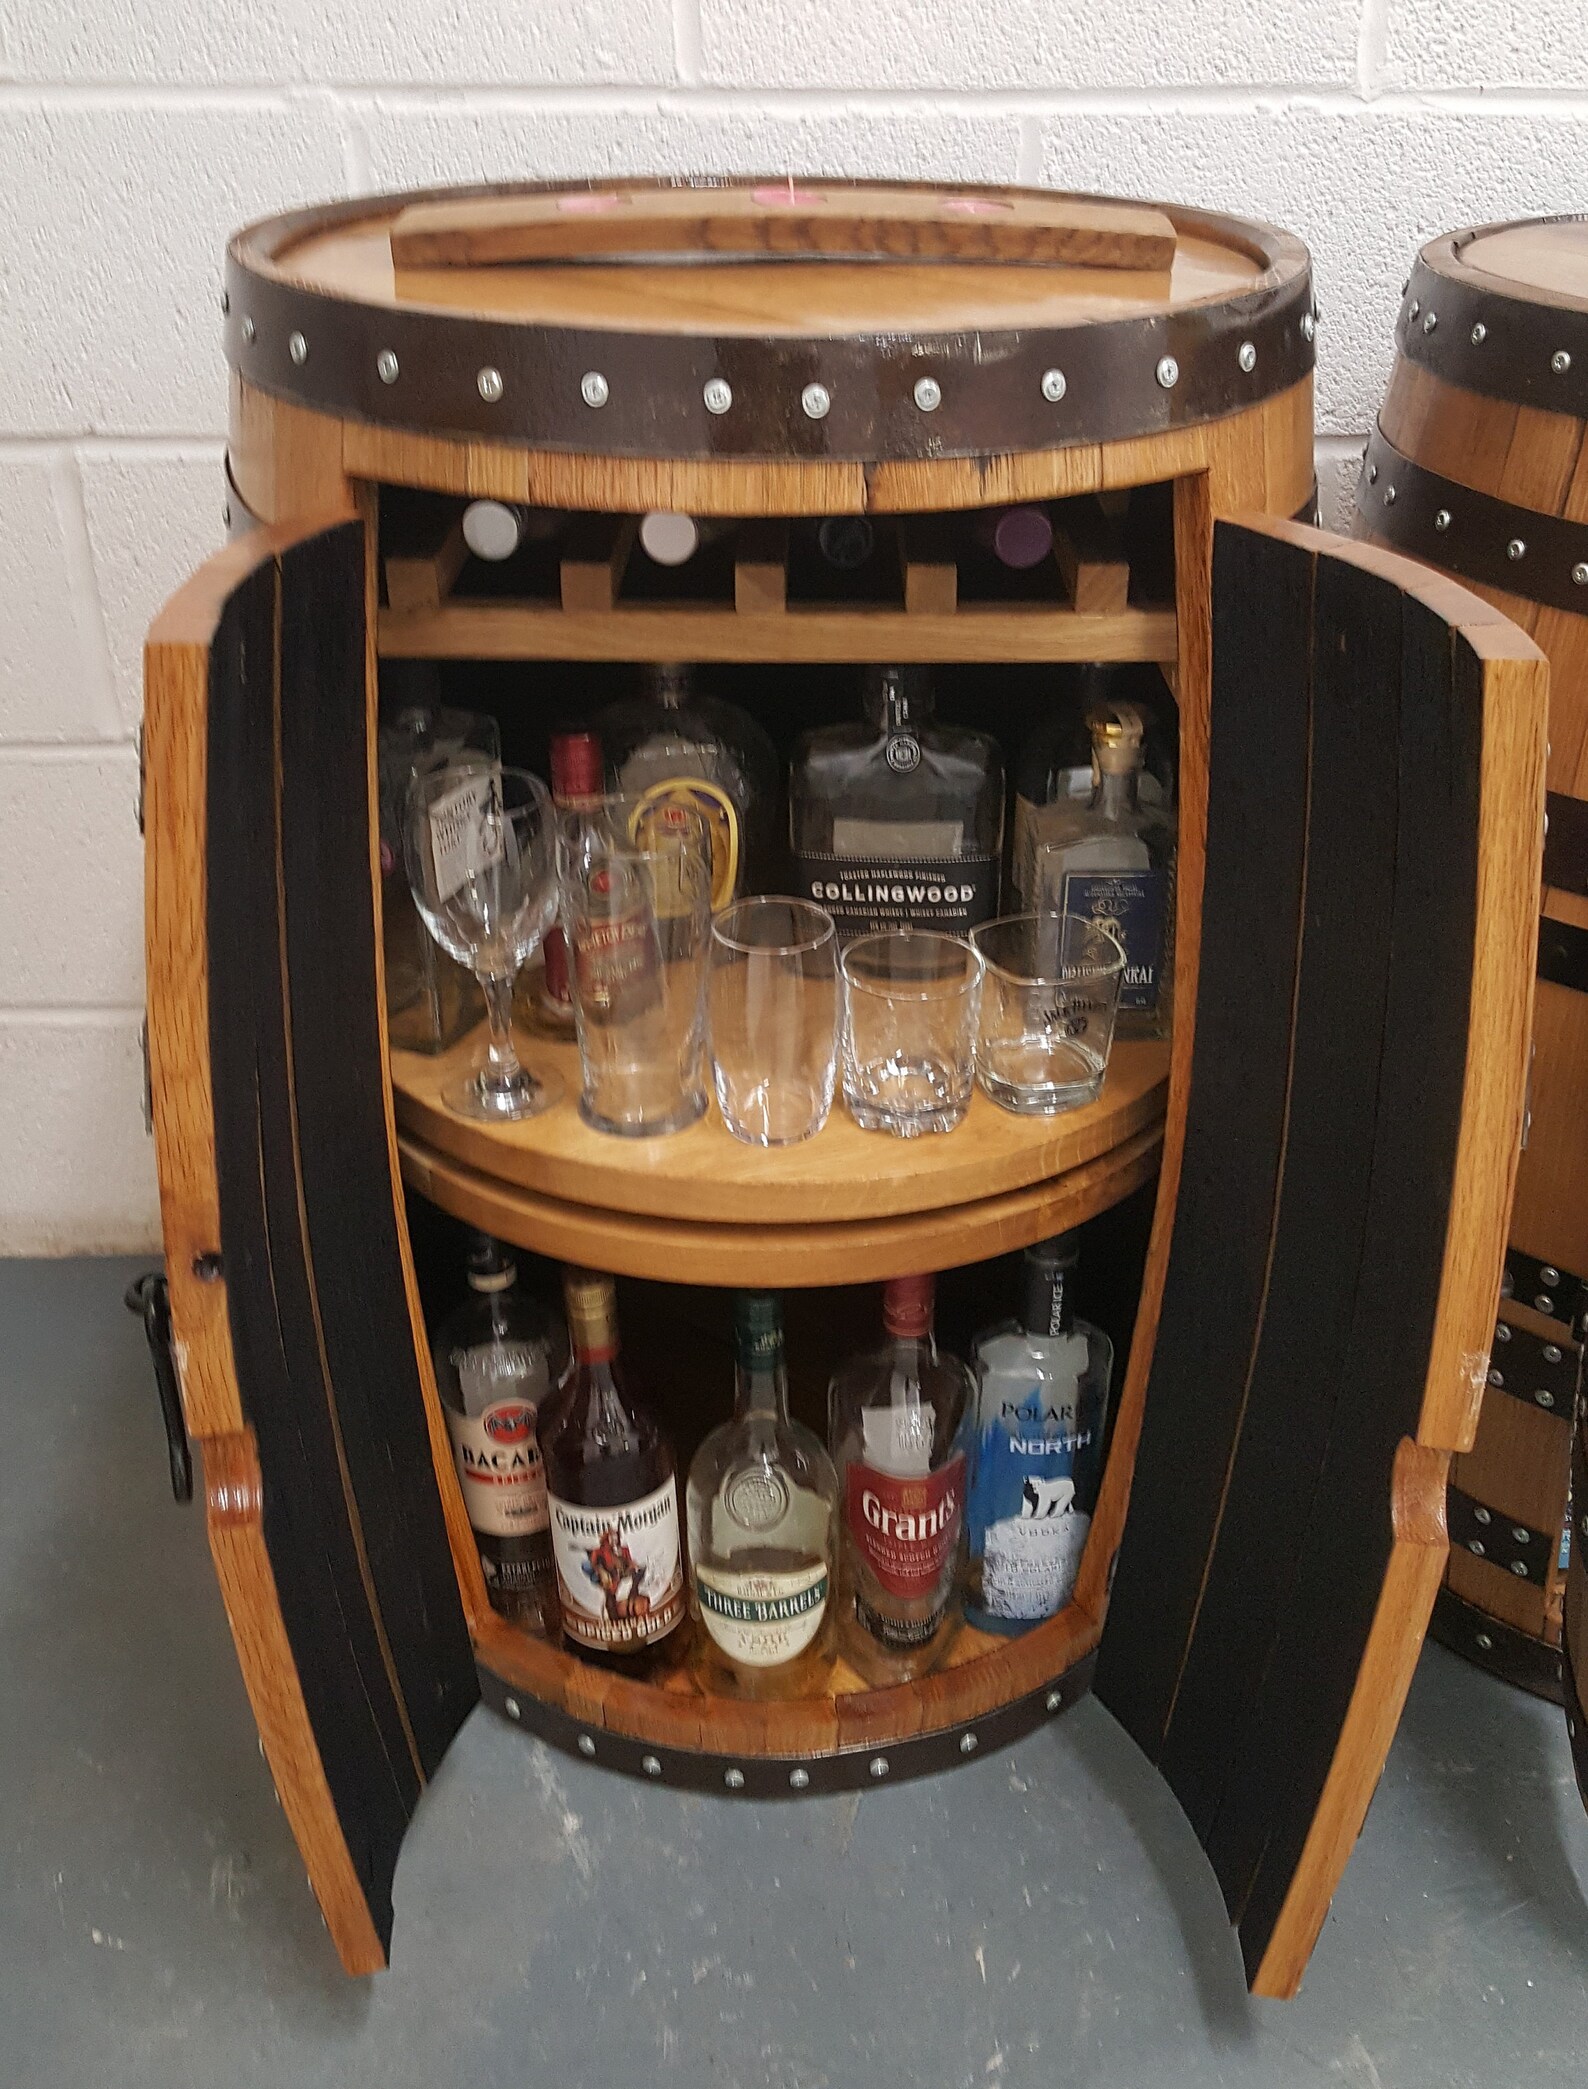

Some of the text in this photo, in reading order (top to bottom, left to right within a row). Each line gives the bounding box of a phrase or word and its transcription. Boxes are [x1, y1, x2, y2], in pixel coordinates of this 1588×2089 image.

[811, 880, 974, 903] COLLINGWOOD
[1001, 1400, 1074, 1422] POLAR
[461, 1442, 541, 1469] BACAR
[1009, 1430, 1091, 1455] NORTH
[555, 1503, 611, 1537] Captain
[617, 1496, 671, 1531] Morgan
[704, 1585, 752, 1620] THREE
[755, 1587, 821, 1622] BARRELS
